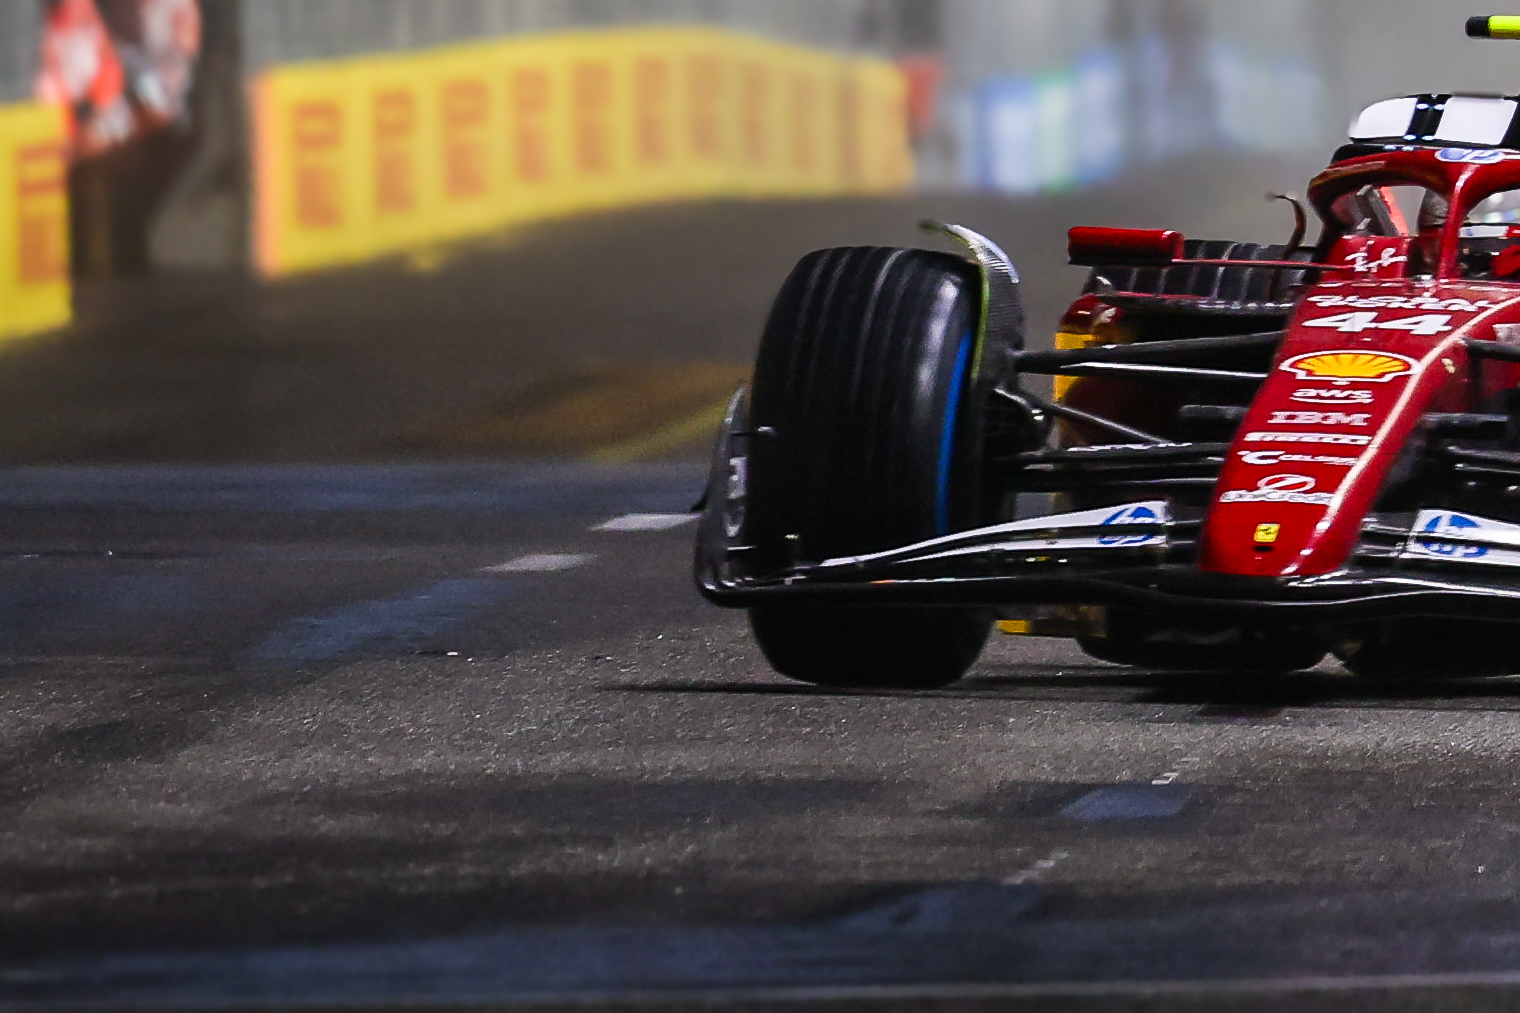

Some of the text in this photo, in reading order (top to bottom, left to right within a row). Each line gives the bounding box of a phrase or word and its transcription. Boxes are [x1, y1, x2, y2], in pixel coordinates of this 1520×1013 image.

[1301, 311, 1453, 335] 44
[1290, 388, 1374, 400] aws
[1266, 411, 1373, 426] IBM
